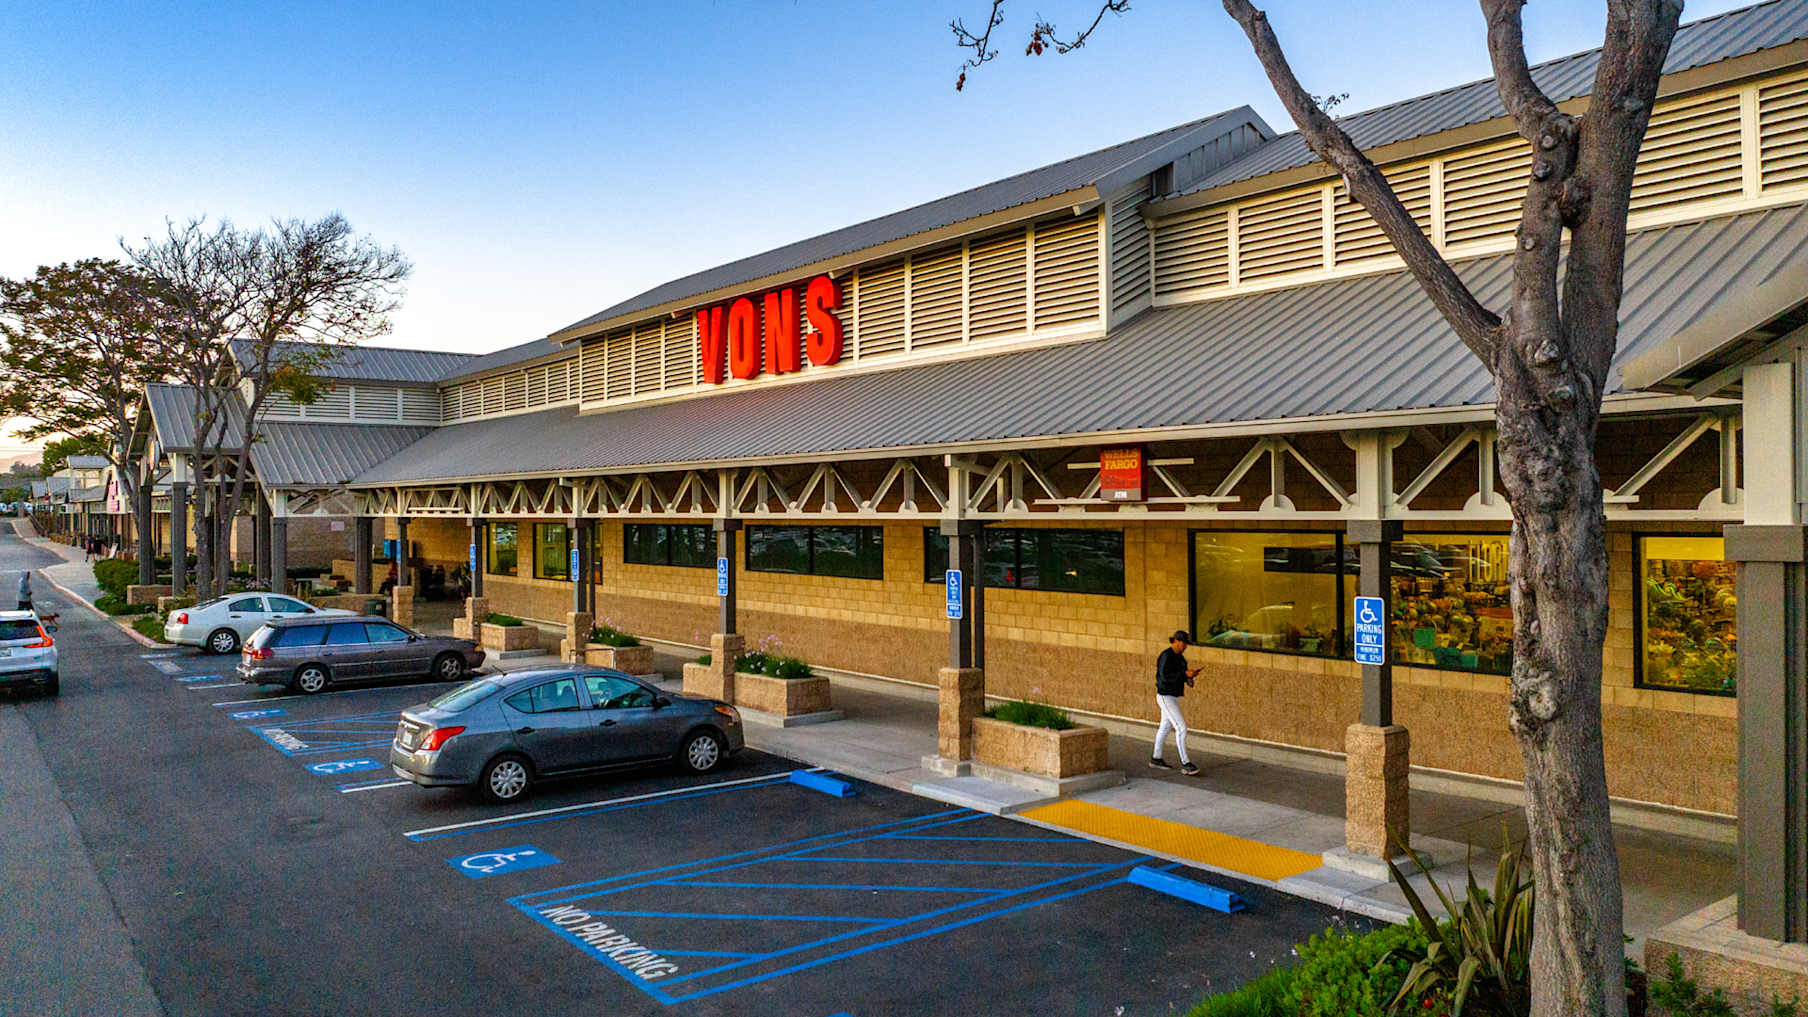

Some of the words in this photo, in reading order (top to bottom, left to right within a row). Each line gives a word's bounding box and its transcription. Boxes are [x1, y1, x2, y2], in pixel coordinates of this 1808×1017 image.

[697, 275, 843, 384] VONS
[1104, 449, 1138, 459] WELLS
[1104, 459, 1138, 470] FARGO
[1357, 623, 1382, 633] PARKING
[1361, 634, 1377, 643] ONLY
[539, 904, 592, 926] NO
[565, 921, 679, 980] PARKING
